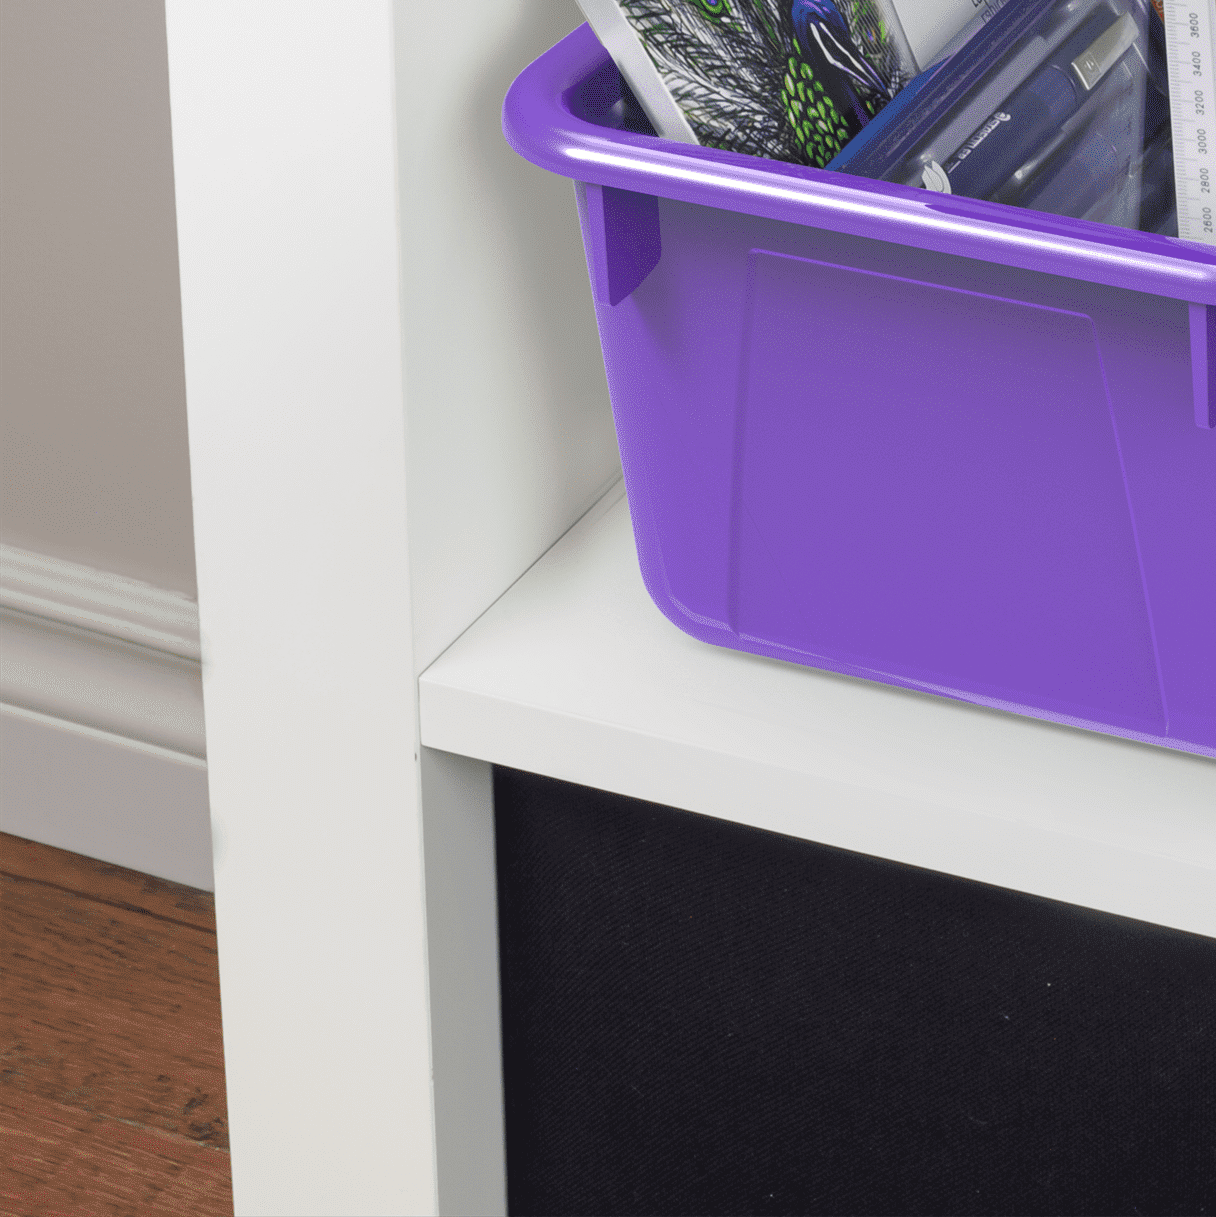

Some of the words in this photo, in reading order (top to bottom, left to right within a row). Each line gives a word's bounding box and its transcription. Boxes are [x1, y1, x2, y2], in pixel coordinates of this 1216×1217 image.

[1189, 12, 1199, 38] 3600
[1192, 51, 1202, 77] 3400
[1194, 89, 1205, 116] 3200
[1197, 128, 1207, 155] 3000
[1200, 167, 1211, 194] 2800
[1202, 207, 1213, 234] 2600
